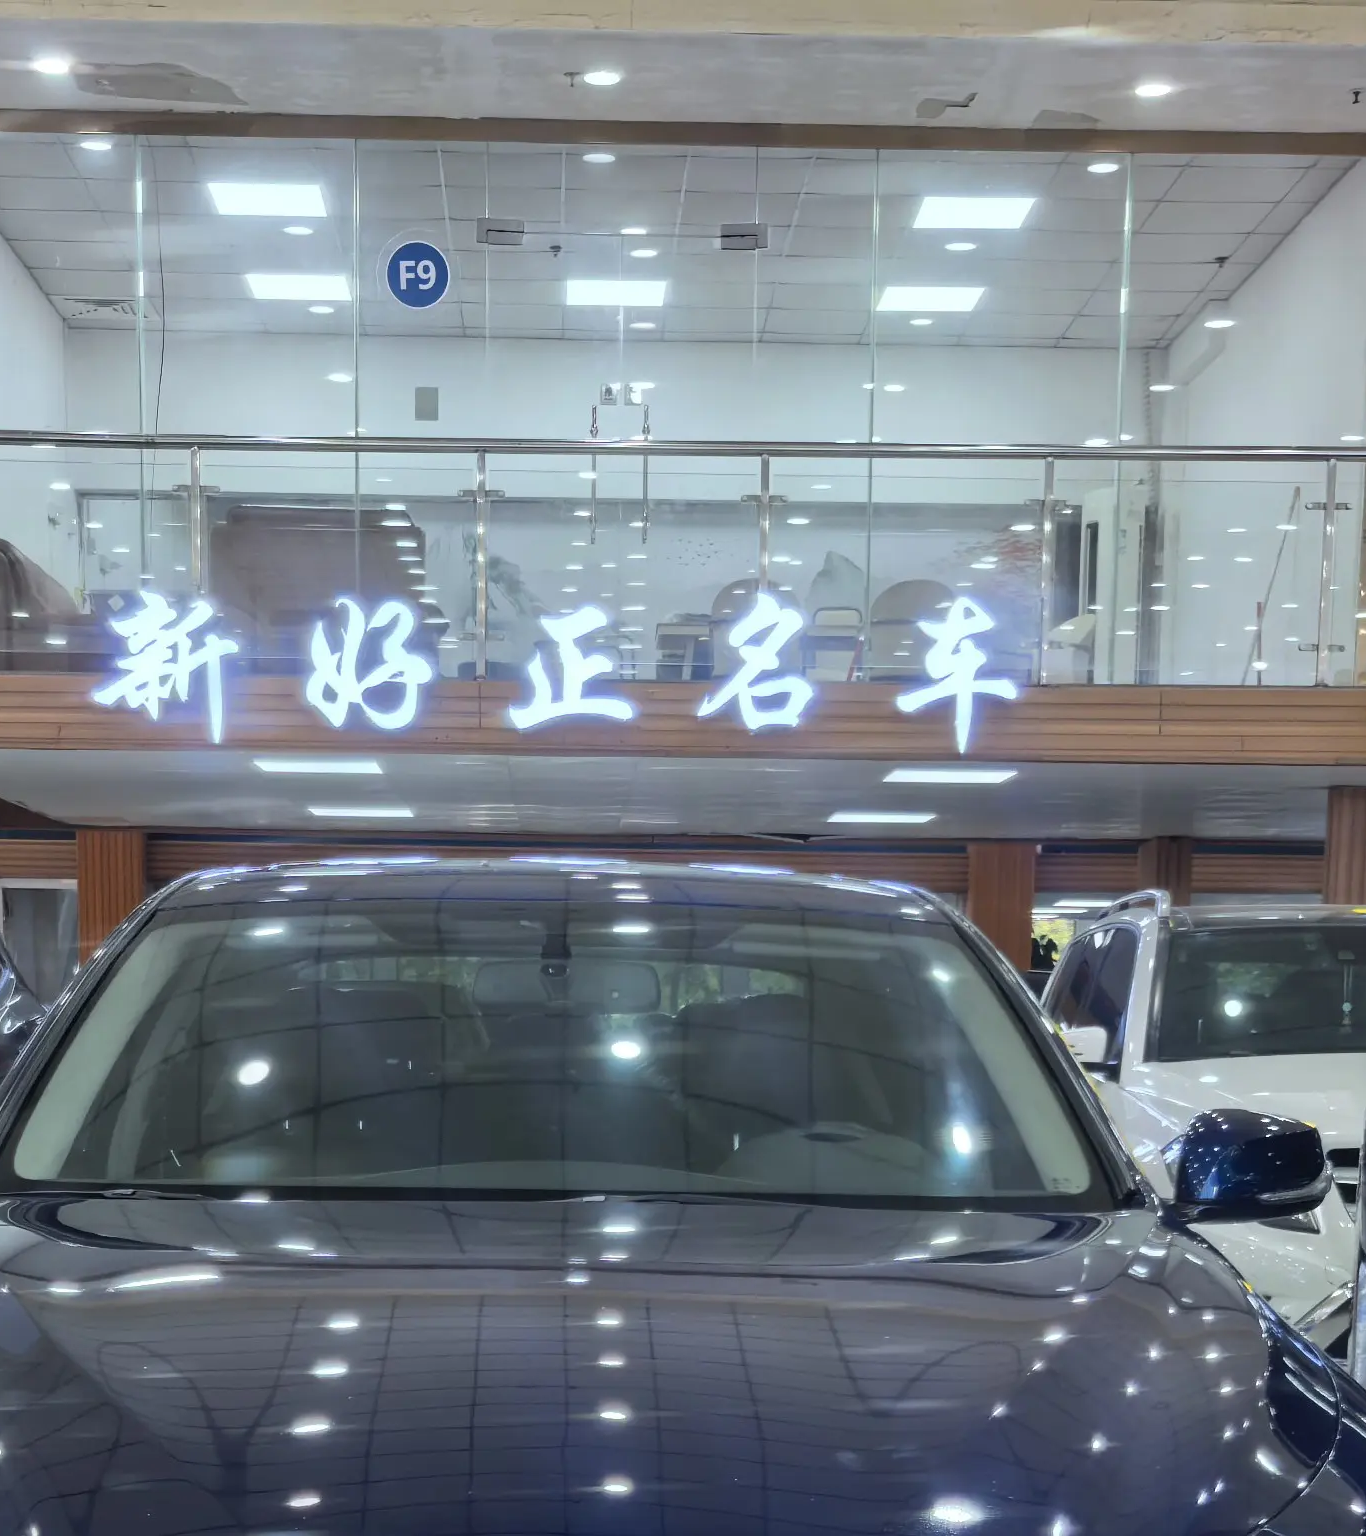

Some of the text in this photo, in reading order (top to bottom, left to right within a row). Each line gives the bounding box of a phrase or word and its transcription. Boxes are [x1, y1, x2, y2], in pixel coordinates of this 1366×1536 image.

[399, 260, 436, 290] F9
[91, 590, 1017, 754] 新好正名车
